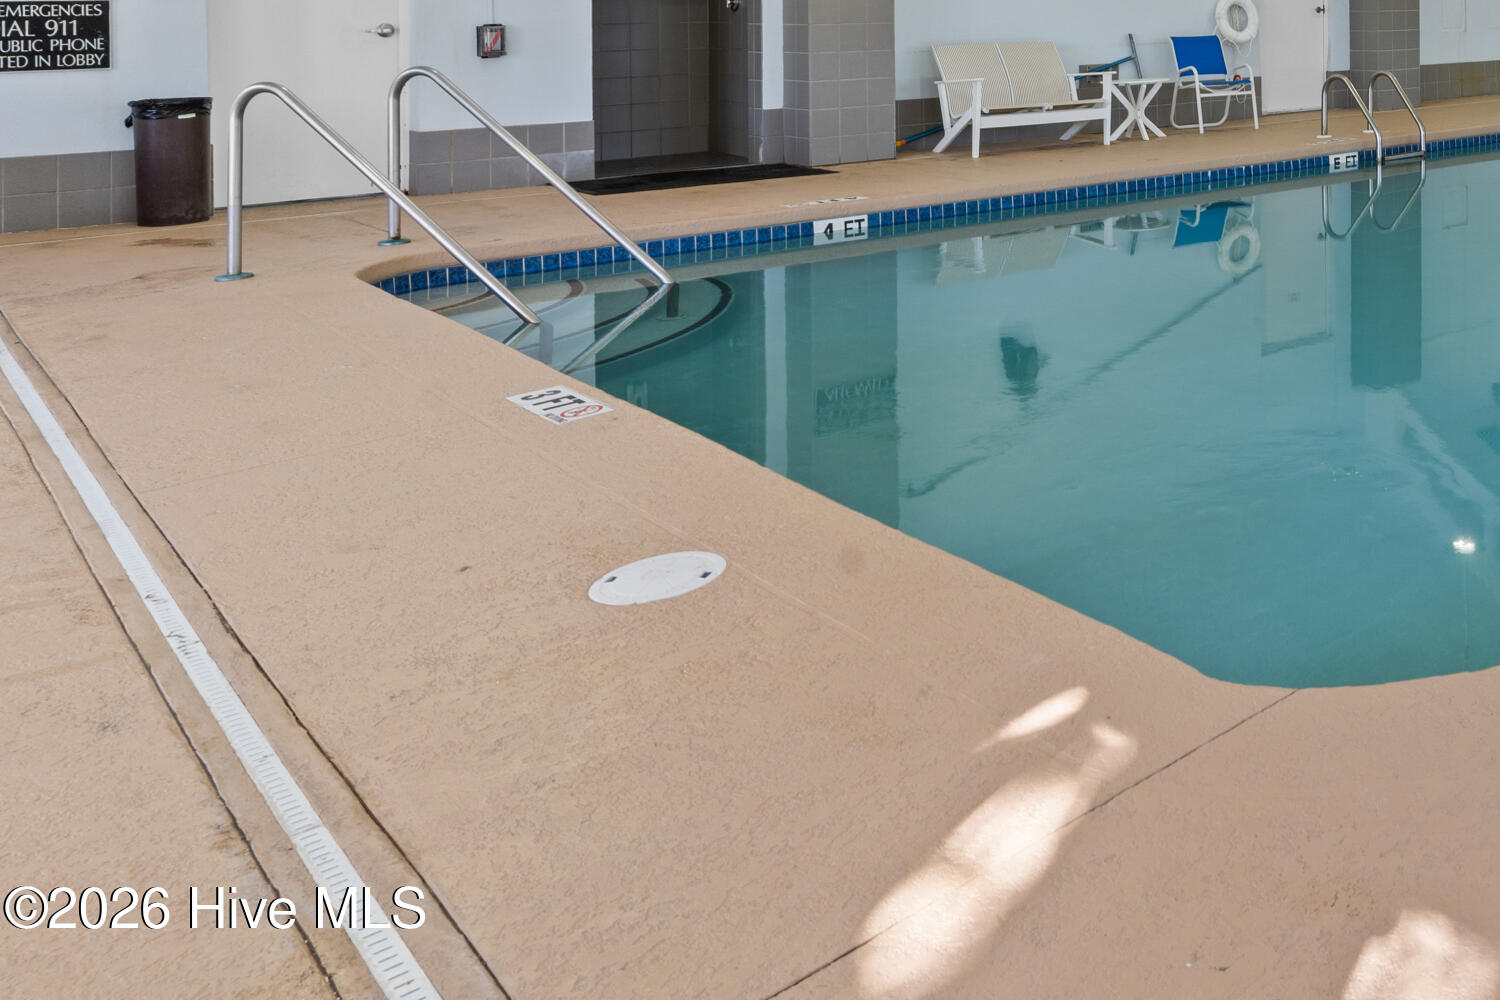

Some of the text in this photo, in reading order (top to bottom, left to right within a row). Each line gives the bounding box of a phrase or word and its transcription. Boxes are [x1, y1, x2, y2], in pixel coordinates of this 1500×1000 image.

[0, 4, 103, 17] EMERGENCIES
[1, 19, 79, 37] IAL 911
[0, 37, 105, 53] UBLIC PHONE
[34, 54, 52, 68] IN
[56, 52, 105, 67] LOBBY
